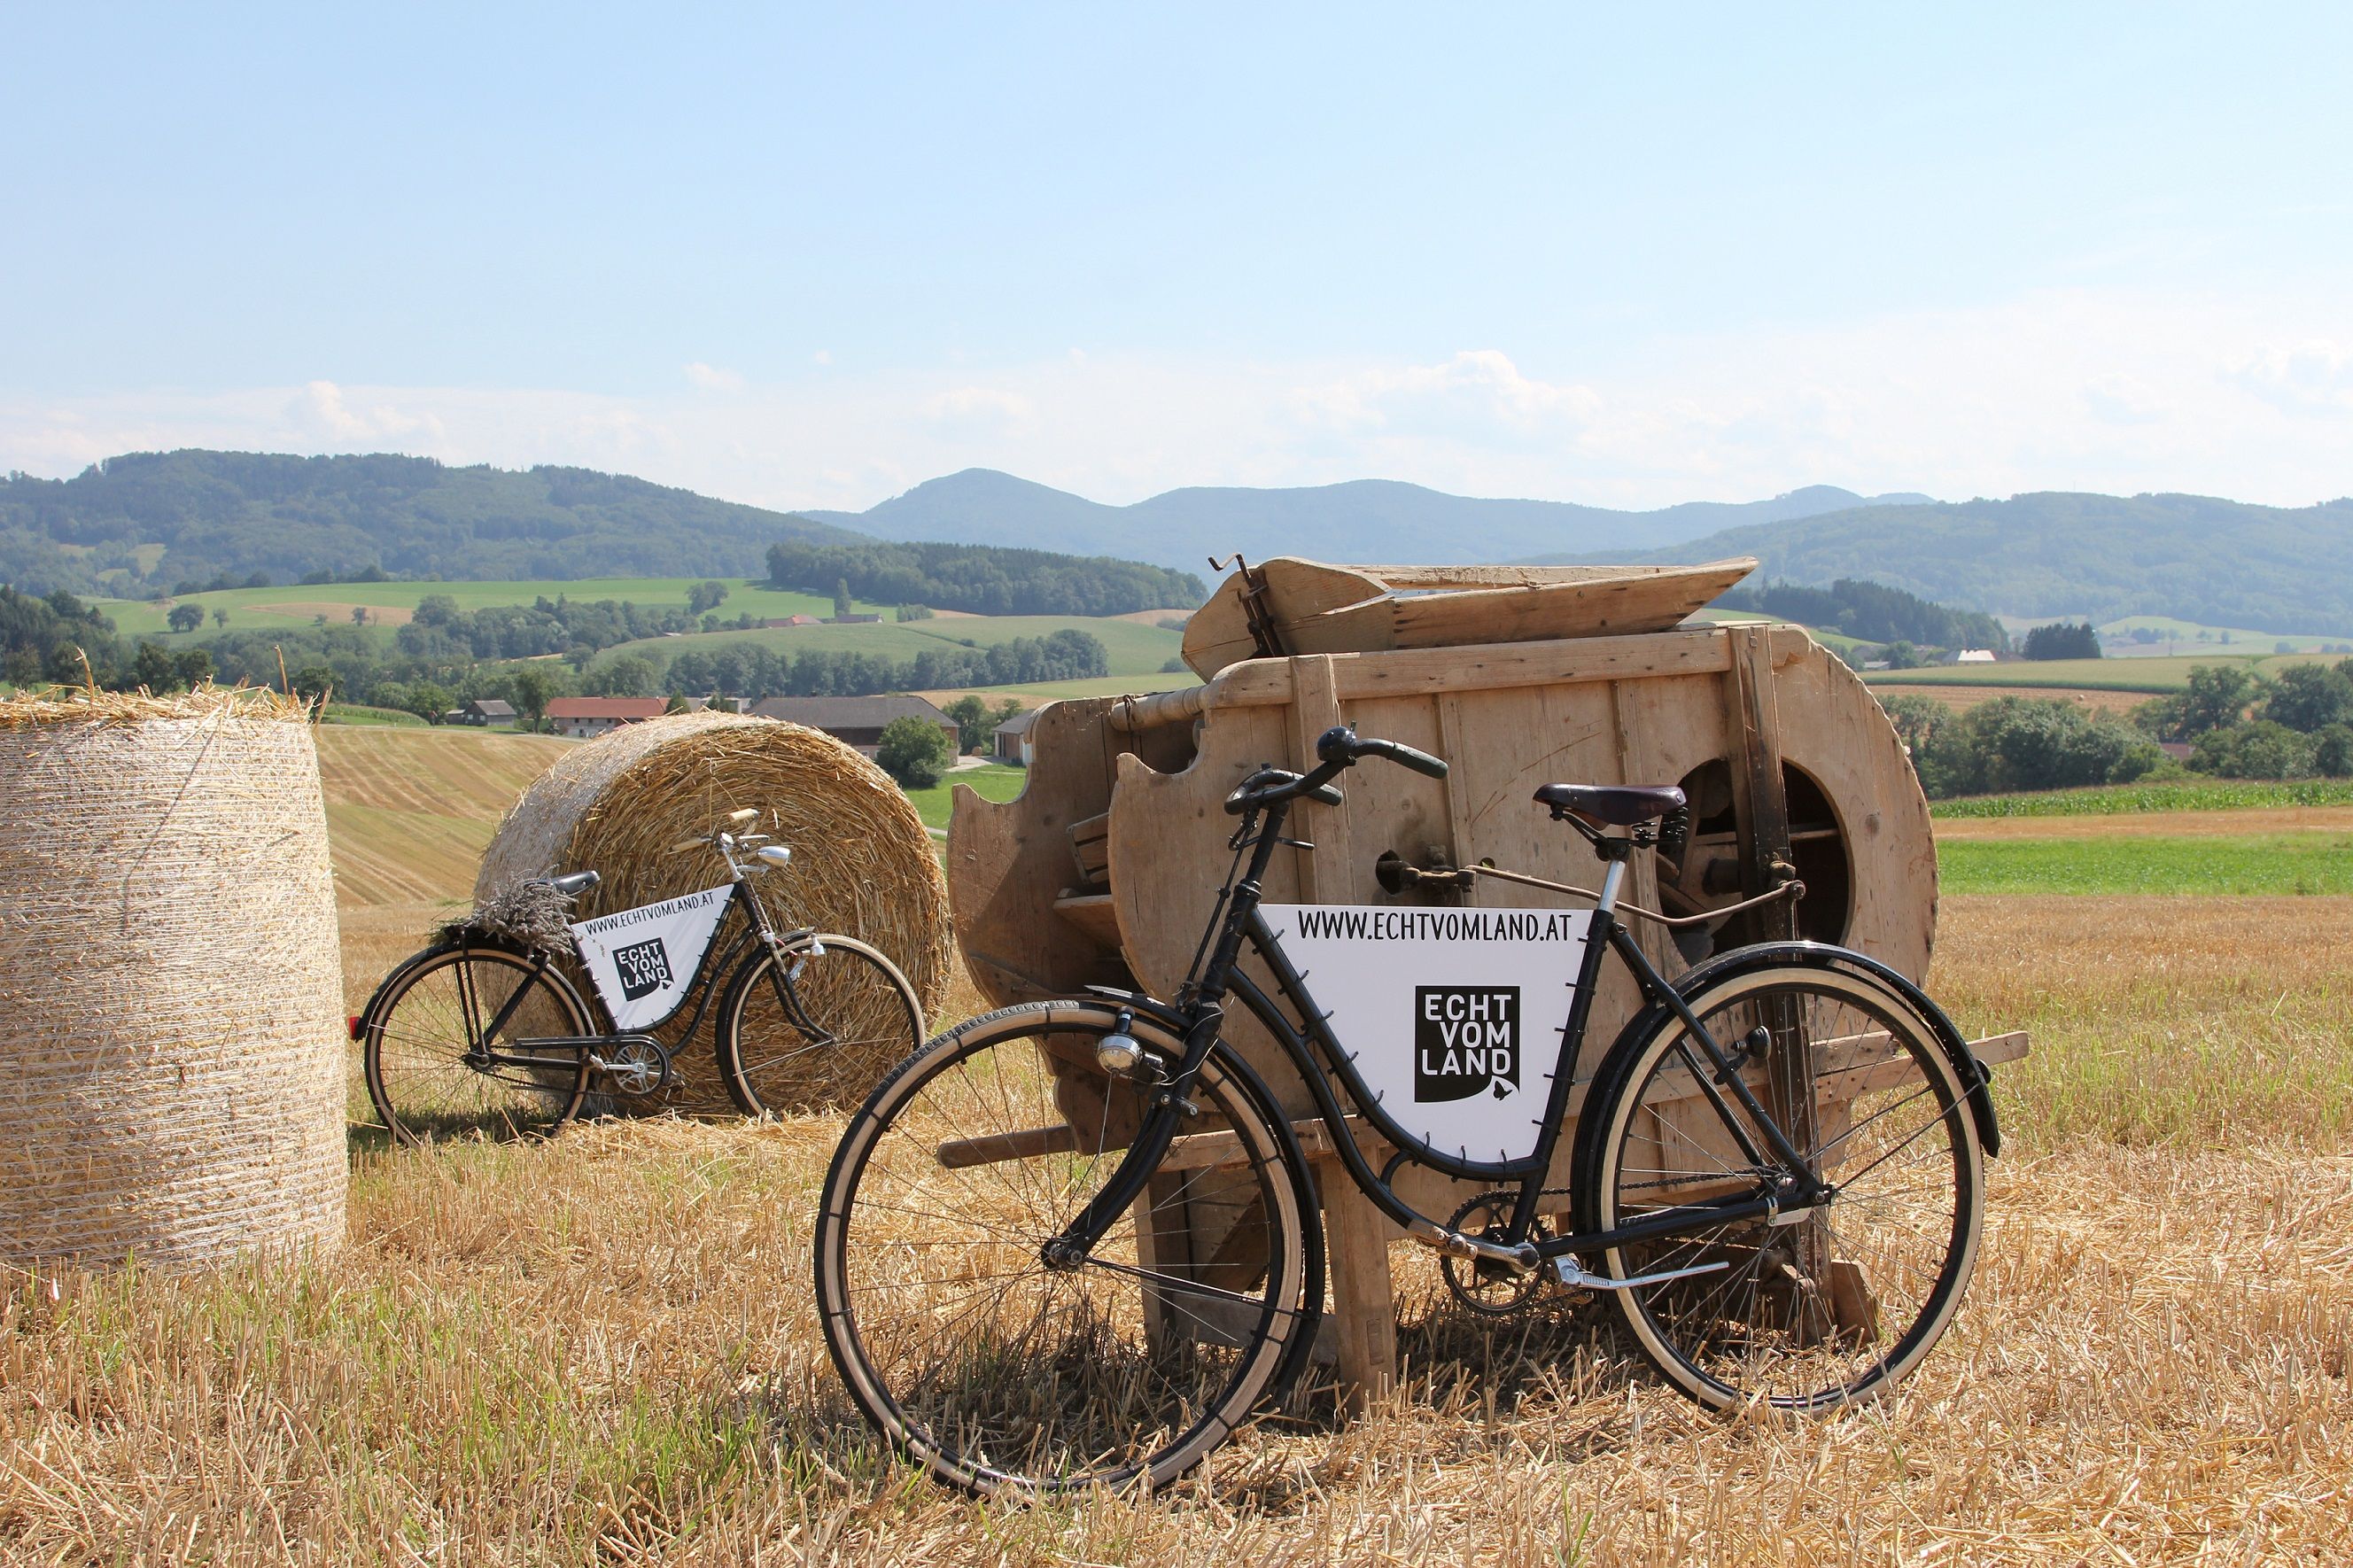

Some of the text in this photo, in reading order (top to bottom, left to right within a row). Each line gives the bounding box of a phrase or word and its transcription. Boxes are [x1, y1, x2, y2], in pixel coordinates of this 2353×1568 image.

[586, 891, 714, 935] WWW.ECHTVOMLAND.AT
[1298, 910, 1572, 941] WWW.ECHTVOMLAND.AT
[617, 942, 660, 965] ECHT
[628, 953, 664, 974] VOM
[624, 966, 668, 989] LAND
[1425, 994, 1511, 1021] ECHT
[1440, 1021, 1510, 1048] VOM
[1422, 1049, 1511, 1075] LAND
